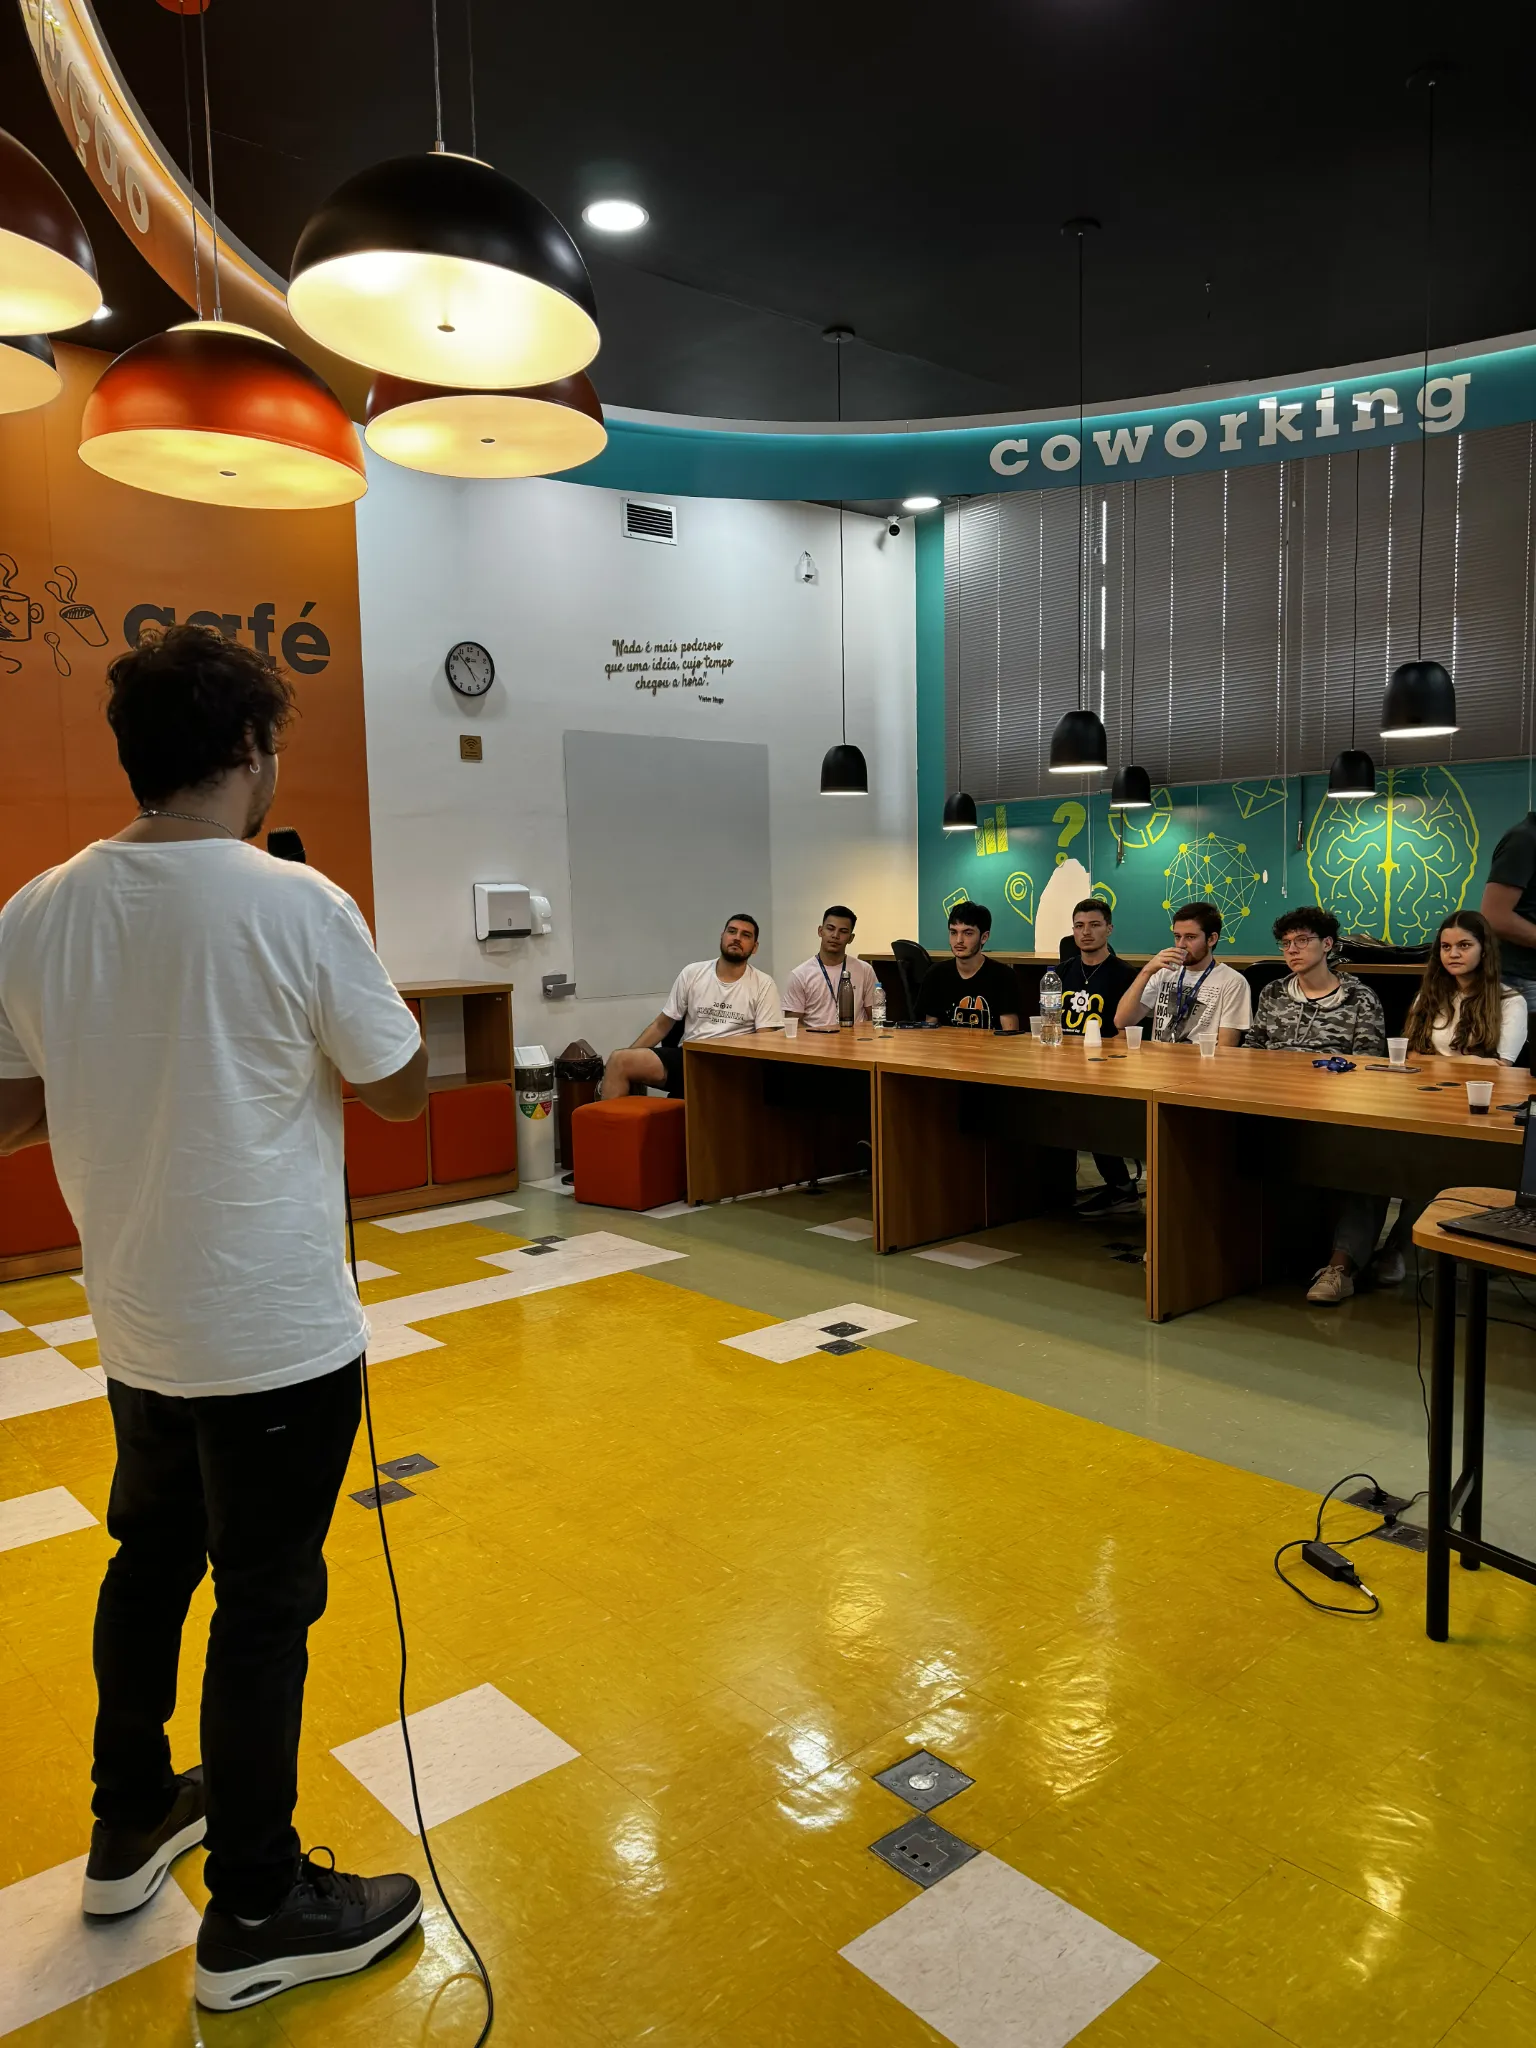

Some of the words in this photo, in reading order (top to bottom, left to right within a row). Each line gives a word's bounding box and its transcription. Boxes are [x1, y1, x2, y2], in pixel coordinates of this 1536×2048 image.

[989, 373, 1472, 476] coworking
[645, 641, 652, 653] é
[654, 640, 678, 653] mais
[680, 638, 723, 658] poderoso
[604, 662, 624, 679] que
[626, 662, 650, 672] uma
[682, 656, 702, 675] cujo
[703, 655, 734, 674] tempo
[635, 675, 670, 696] chegou
[672, 679, 680, 687] a
